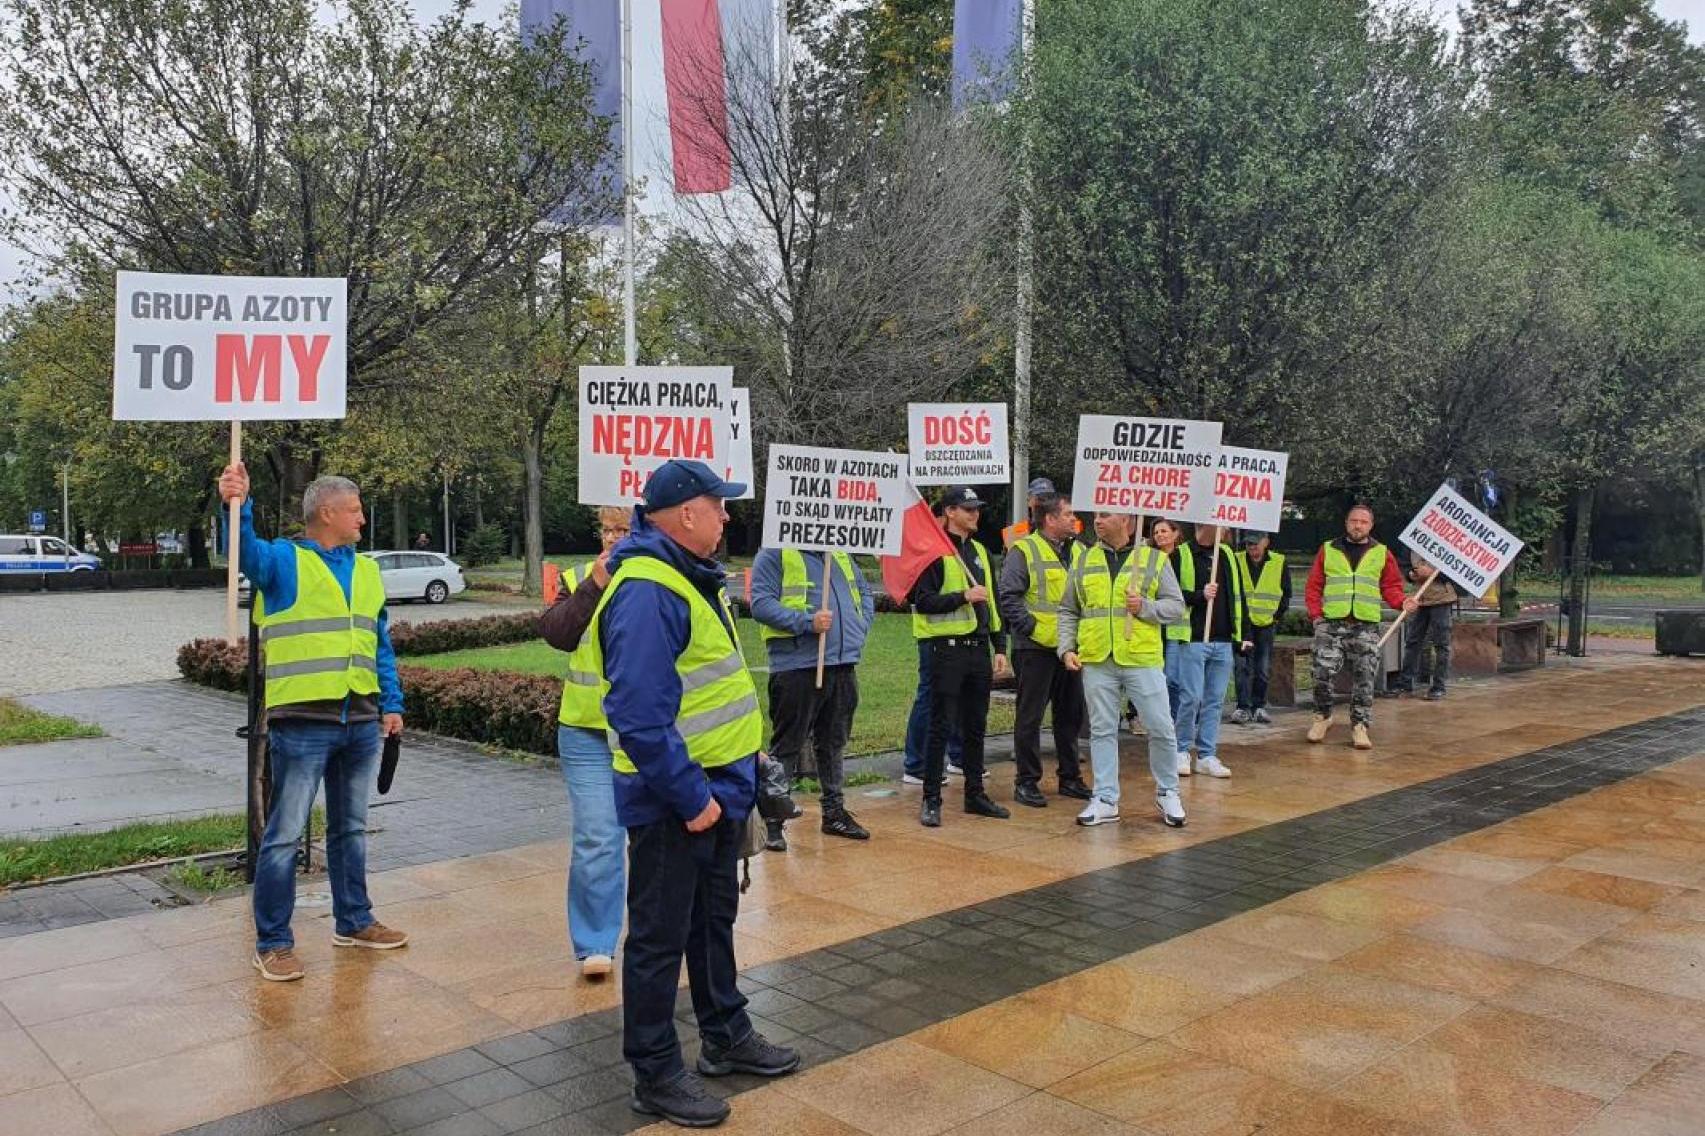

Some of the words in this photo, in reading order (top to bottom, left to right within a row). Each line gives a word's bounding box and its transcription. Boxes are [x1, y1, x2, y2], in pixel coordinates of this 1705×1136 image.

[131, 291, 232, 321] GRUPA
[242, 295, 333, 322] AZOTY
[133, 344, 194, 390] TO
[215, 333, 331, 403] MY
[587, 376, 650, 411] CIĘŻKA
[657, 382, 723, 411] PRACA,
[592, 414, 714, 465] NĘDZNA
[924, 409, 992, 445] DOŚĆ
[1112, 421, 1186, 449] GDZIE
[777, 454, 820, 474] SKORO
[824, 458, 837, 474] W
[840, 460, 899, 479] AZOTACH
[915, 465, 928, 477] NA
[1098, 464, 1122, 483] ZA
[1128, 465, 1191, 488] CHORE
[1232, 455, 1280, 476] PRACA,
[790, 475, 831, 499] TAKA
[836, 479, 882, 504] BIDA,
[1094, 486, 1190, 511] DECYZJE?
[1214, 472, 1272, 502] DZNA
[776, 499, 791, 516] TO
[794, 501, 829, 521] SKĄD
[834, 504, 893, 523] WYPŁATY
[779, 521, 885, 549] PREZESÓW!
[1421, 508, 1500, 572] ZŁODZIEJSTWO
[1436, 496, 1511, 556] AROGANCJA
[1409, 527, 1485, 588] KOLESIOSTWO
